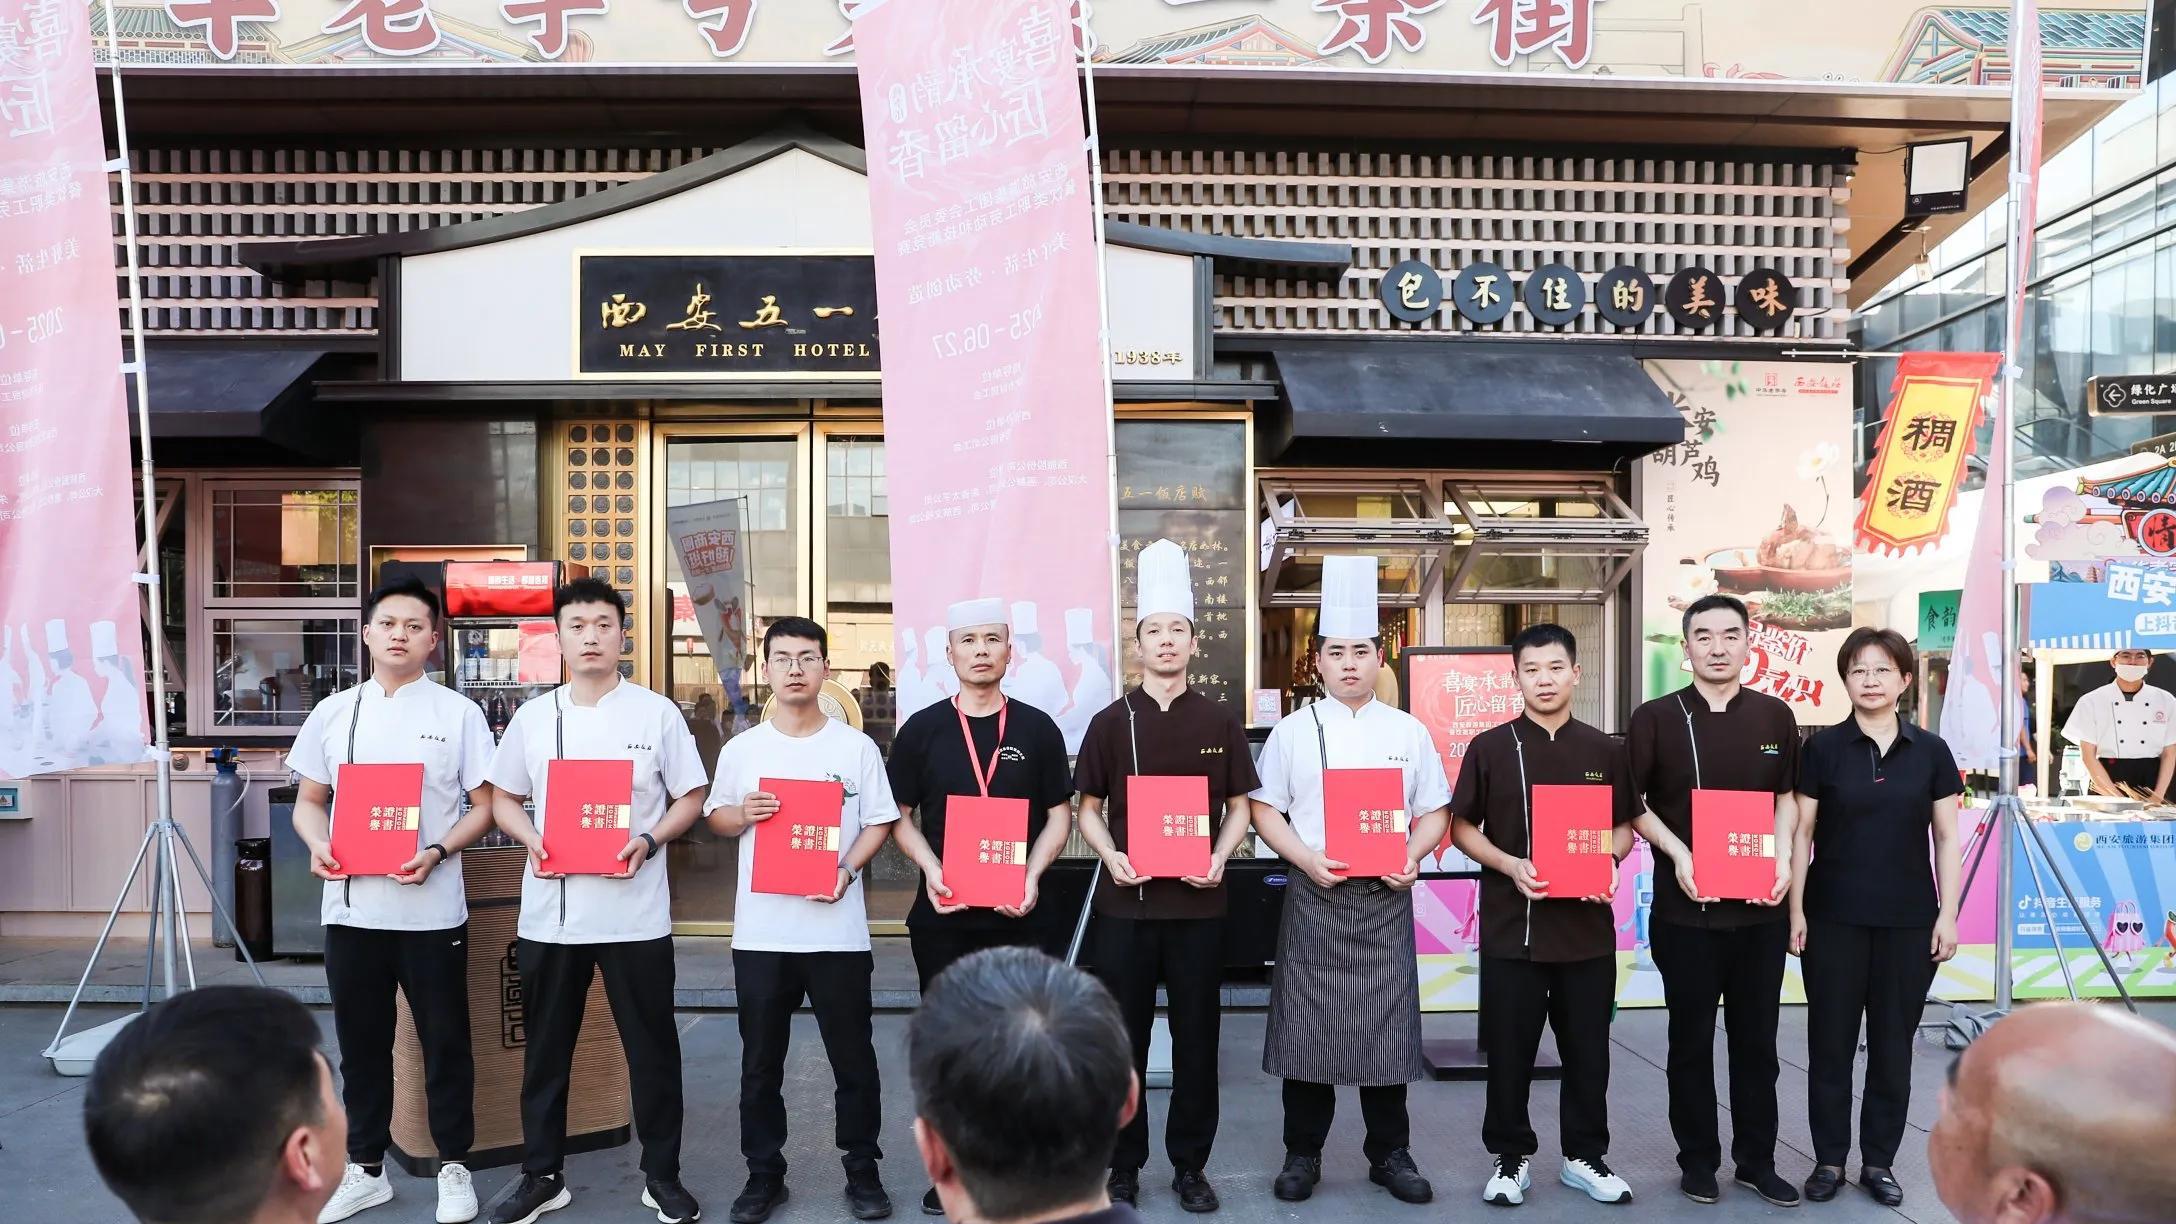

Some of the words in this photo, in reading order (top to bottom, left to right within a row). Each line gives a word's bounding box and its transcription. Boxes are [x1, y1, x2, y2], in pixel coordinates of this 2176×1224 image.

[1397, 275, 1787, 319] 包不住的美味
[619, 344, 667, 357] MAY
[695, 344, 764, 357] FIRST
[793, 344, 871, 357] HOTEL
[1114, 351, 1183, 366] 1938年
[1887, 417, 1957, 512] 稠酒
[2139, 615, 2176, 632] 上抖
[2096, 834, 2174, 845] 西安旅游集团
